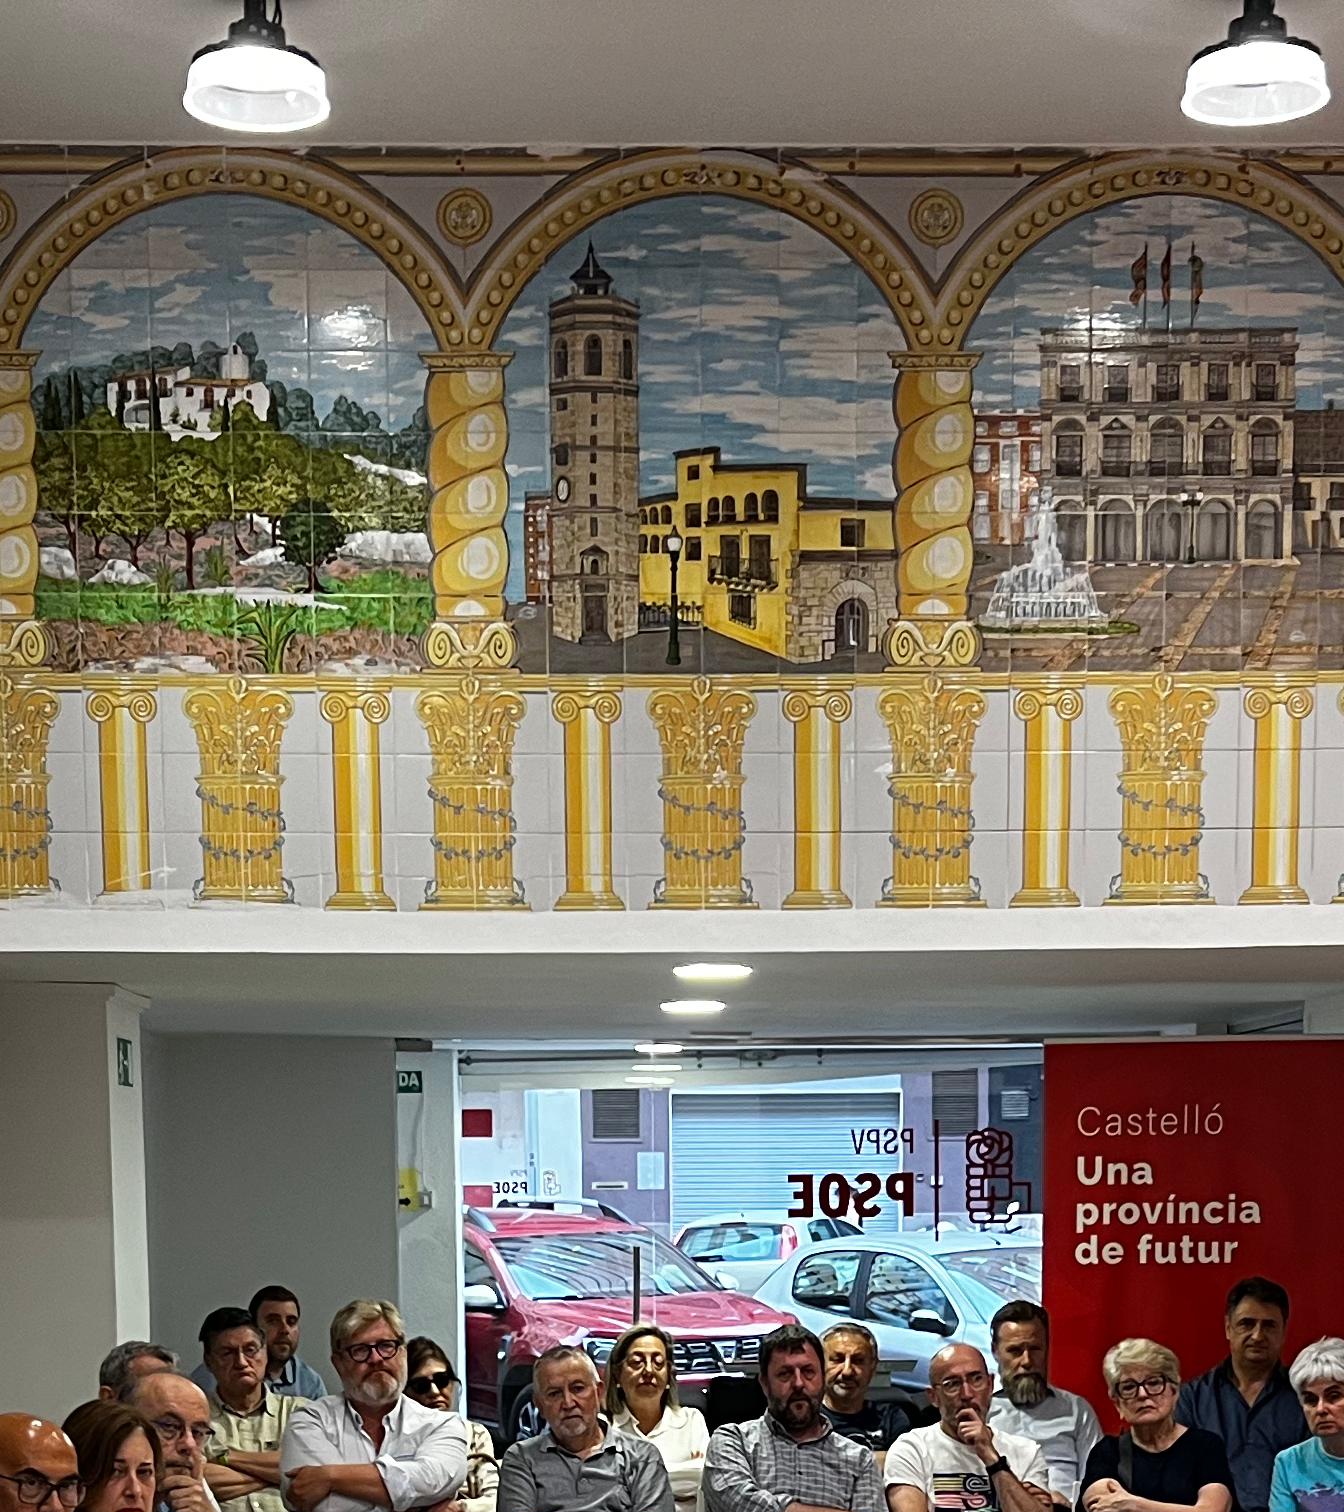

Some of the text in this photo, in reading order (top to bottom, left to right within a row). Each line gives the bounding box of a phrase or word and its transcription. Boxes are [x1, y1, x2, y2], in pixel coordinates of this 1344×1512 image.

[1077, 1103, 1223, 1136] Castelló
[1076, 1155, 1153, 1185] Una
[1075, 1193, 1261, 1234] província
[1074, 1233, 1238, 1265] de futur
